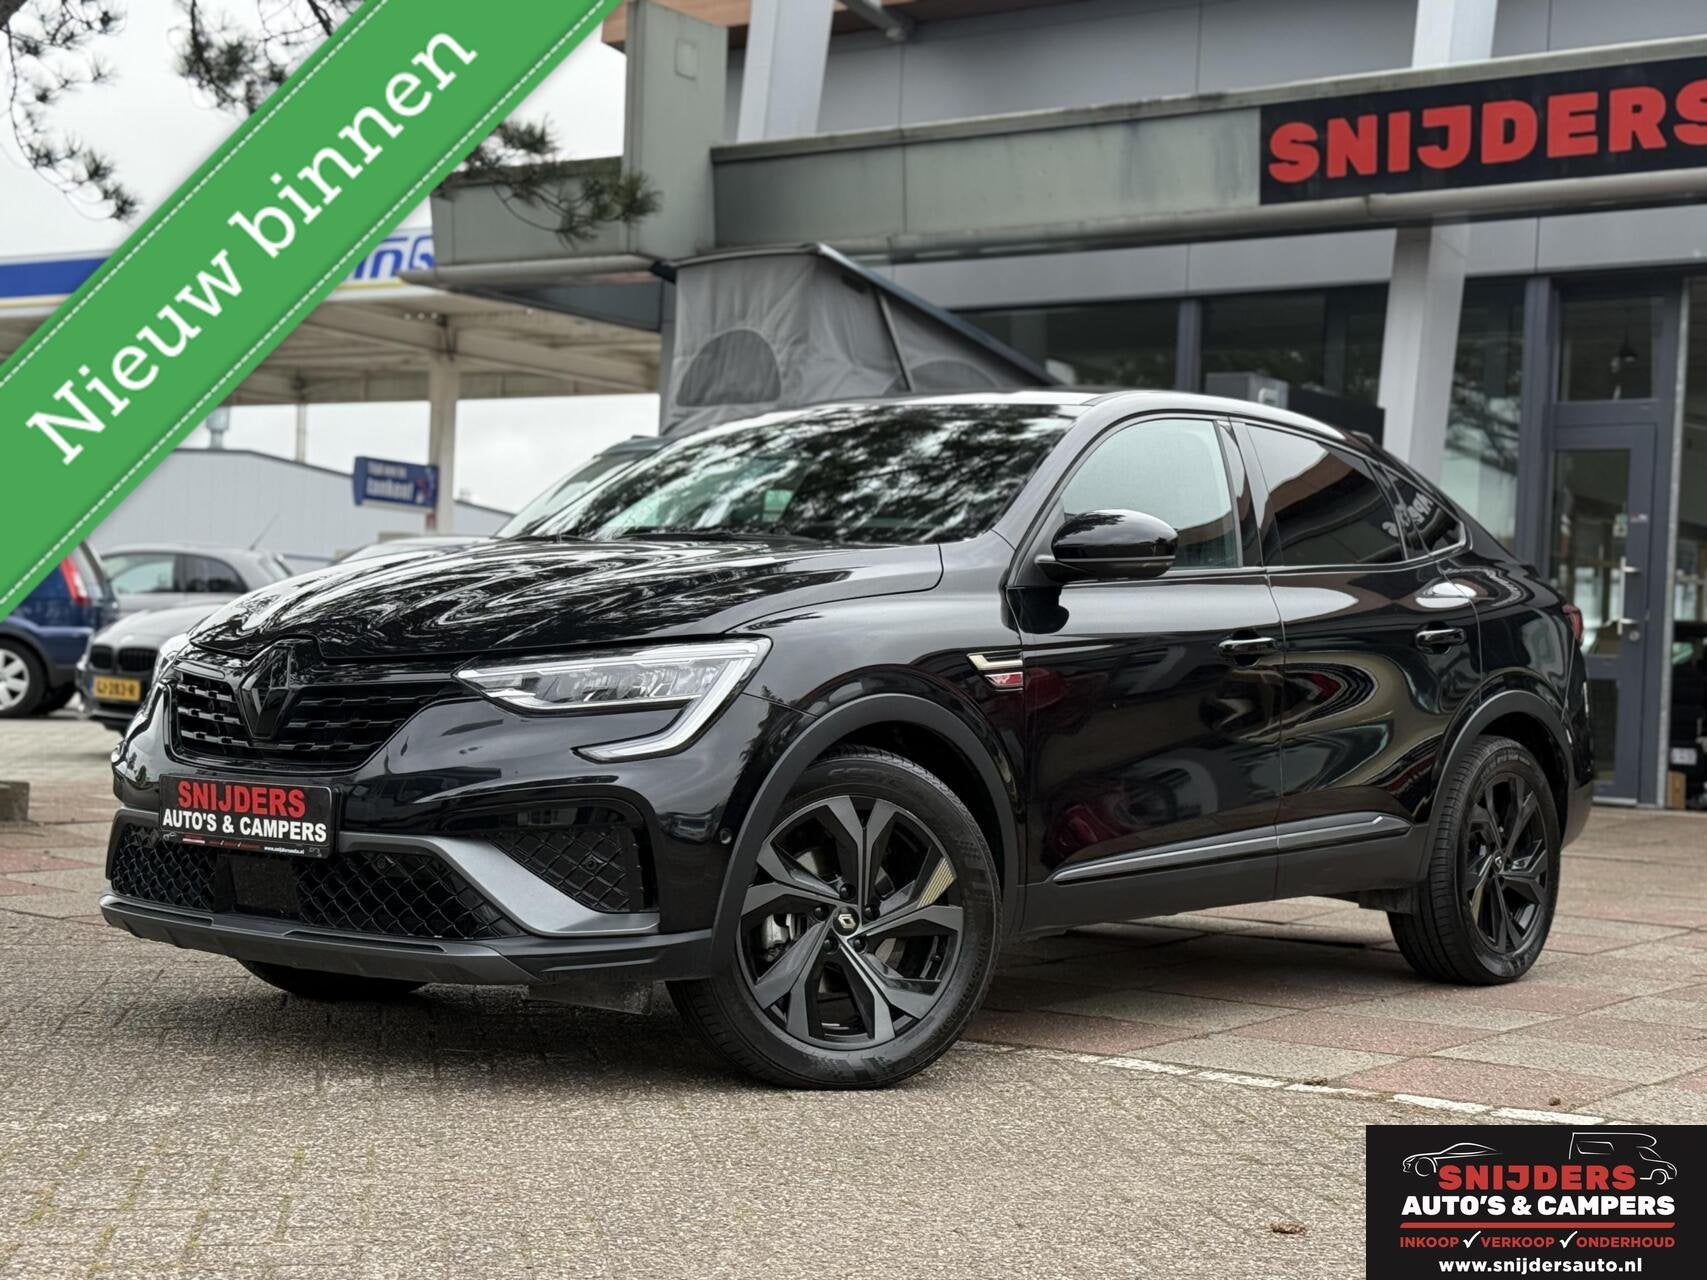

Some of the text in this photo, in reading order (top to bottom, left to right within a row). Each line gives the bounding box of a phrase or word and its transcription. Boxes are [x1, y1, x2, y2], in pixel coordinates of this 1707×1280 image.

[1268, 79, 1707, 183] SNIJDERS
[178, 780, 306, 818] SNIJDERS
[162, 808, 327, 843] AUTO'S & CAMPERS
